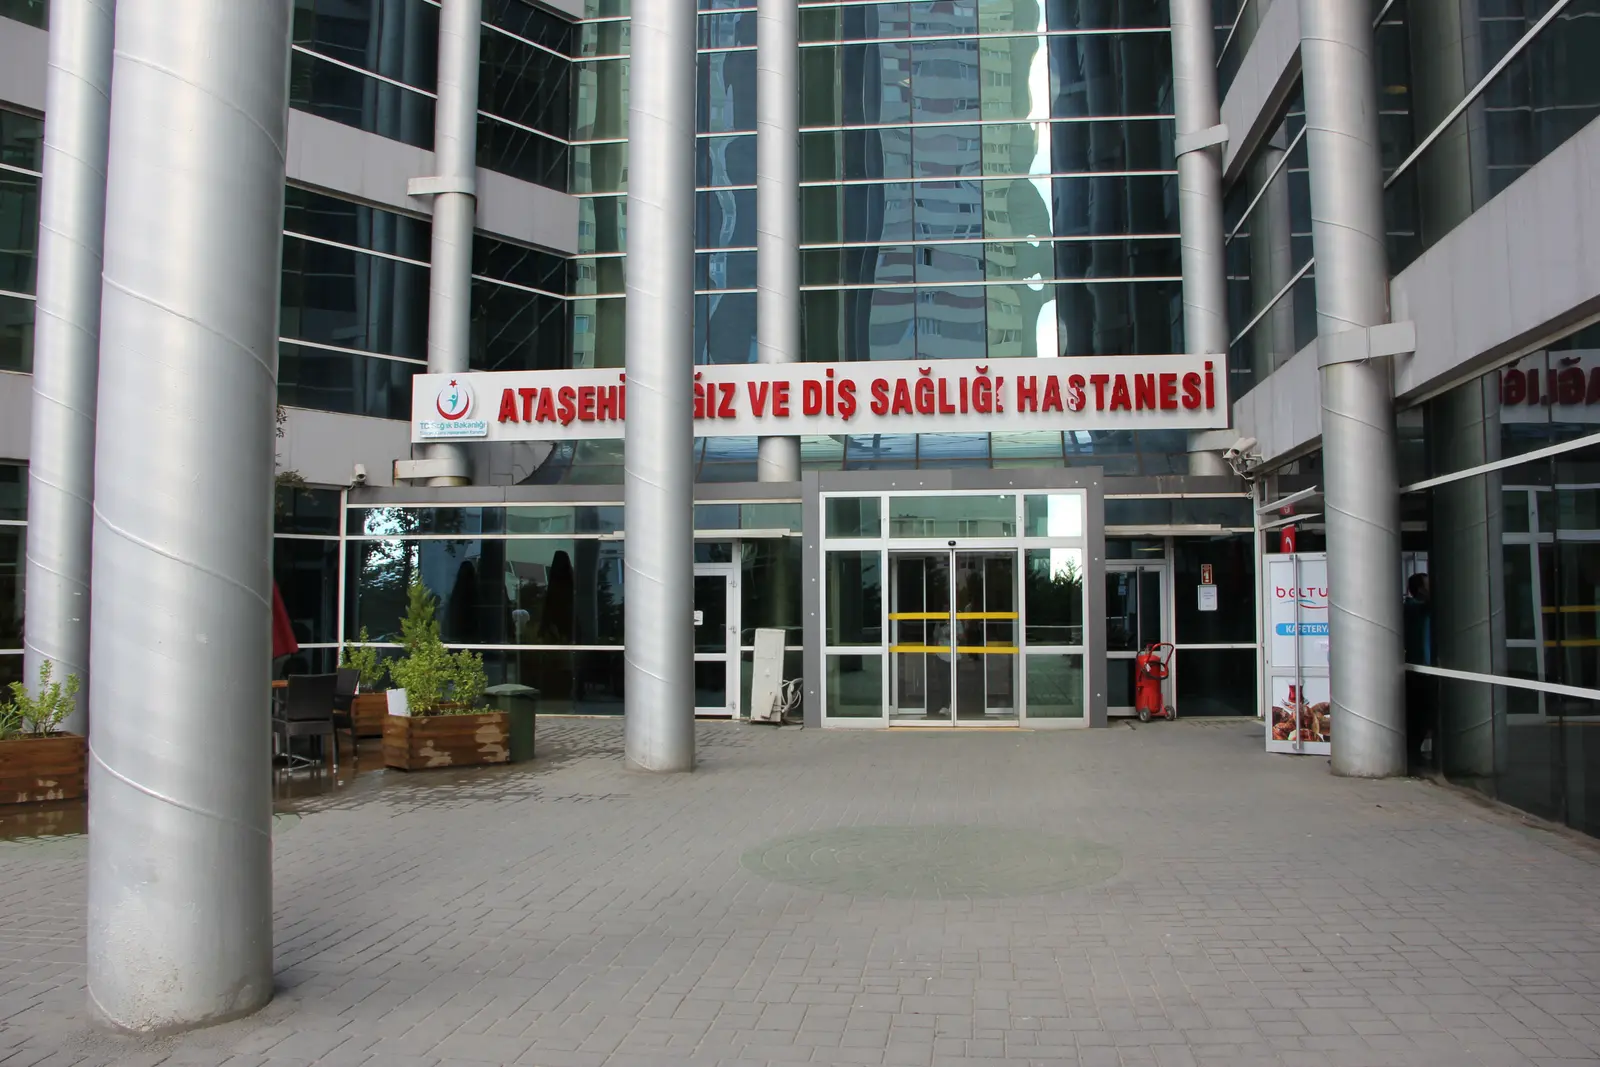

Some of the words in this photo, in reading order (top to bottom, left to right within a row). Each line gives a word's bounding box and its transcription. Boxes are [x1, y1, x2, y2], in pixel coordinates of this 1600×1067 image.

[498, 374, 625, 426] ATAŞEHİ
[693, 372, 736, 419] ĞIZ
[747, 381, 790, 418] VE
[803, 368, 856, 420] DİŞ
[870, 365, 1004, 415] SAĞLIĞI
[1017, 361, 1214, 412] HASTANESİ
[431, 422, 453, 430] Sağık
[1286, 624, 1329, 633] KAFETERY
